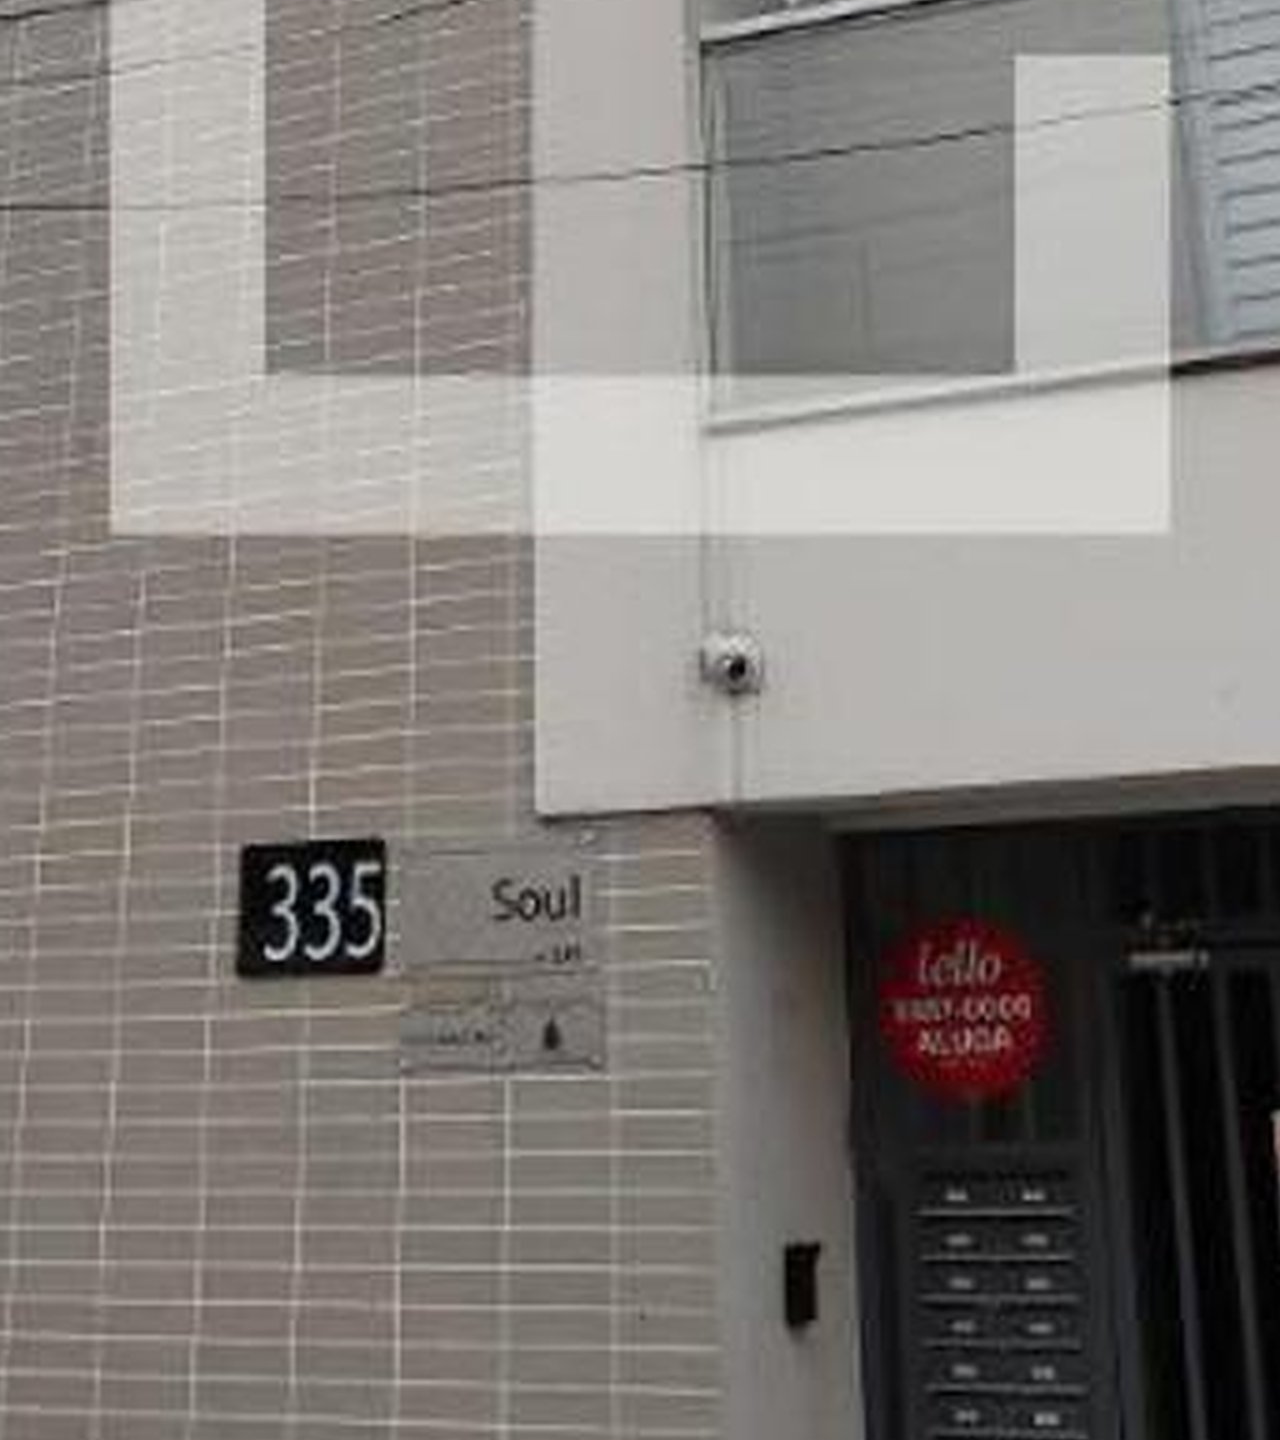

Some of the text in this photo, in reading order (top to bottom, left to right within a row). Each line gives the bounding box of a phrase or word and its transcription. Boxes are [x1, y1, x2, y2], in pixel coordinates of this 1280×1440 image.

[262, 862, 382, 962] 335
[490, 874, 582, 923] Soul
[917, 1023, 1015, 1057] ALUGA
